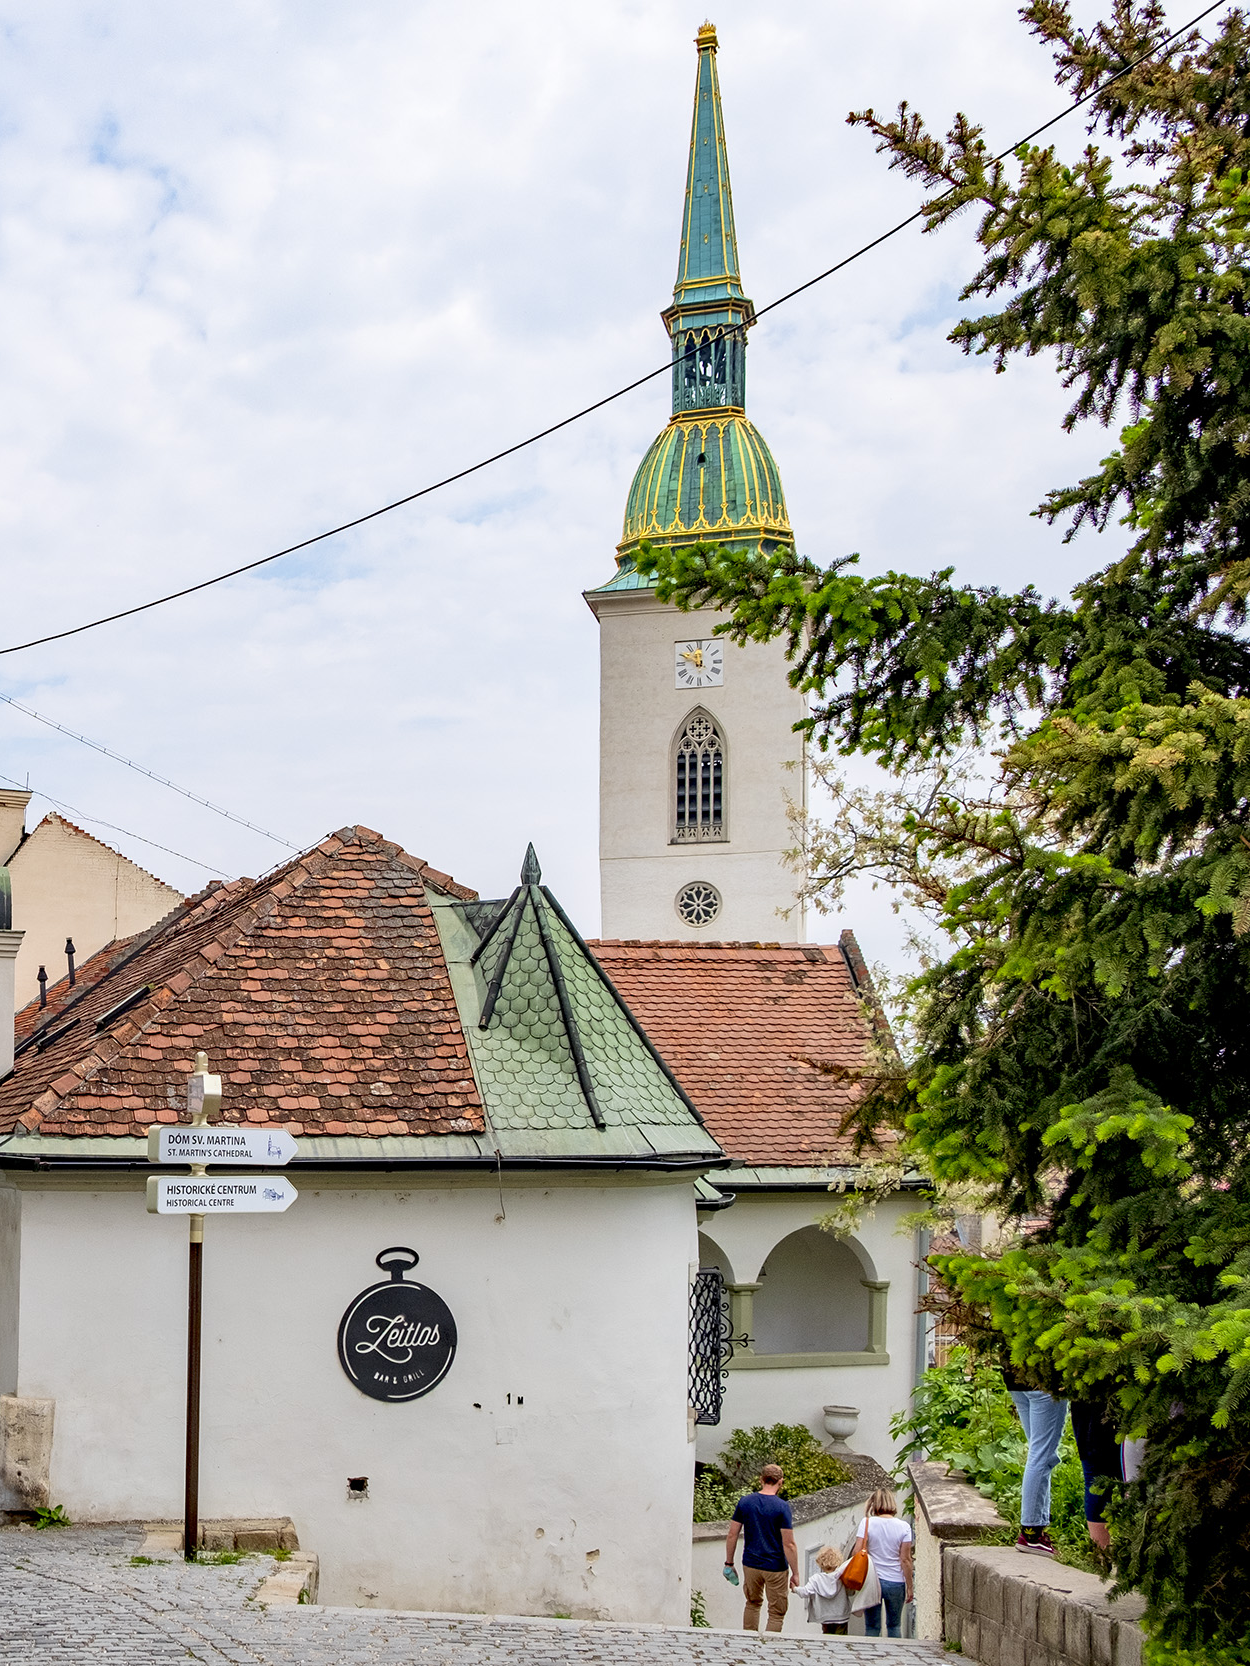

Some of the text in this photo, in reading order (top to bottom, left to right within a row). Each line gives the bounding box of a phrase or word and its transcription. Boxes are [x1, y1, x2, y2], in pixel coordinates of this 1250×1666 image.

[168, 1133, 246, 1146] DÓM SV. MARTINA
[167, 1149, 253, 1158] ST. MARTIN'S CATHEDRAL
[167, 1184, 257, 1195] HISTORICKÉ CENTRUM
[166, 1199, 235, 1207] HISTORICAL CENTRE
[355, 1314, 440, 1364] Zeitlos
[374, 1371, 389, 1384] BAR
[403, 1369, 425, 1384] GRILL
